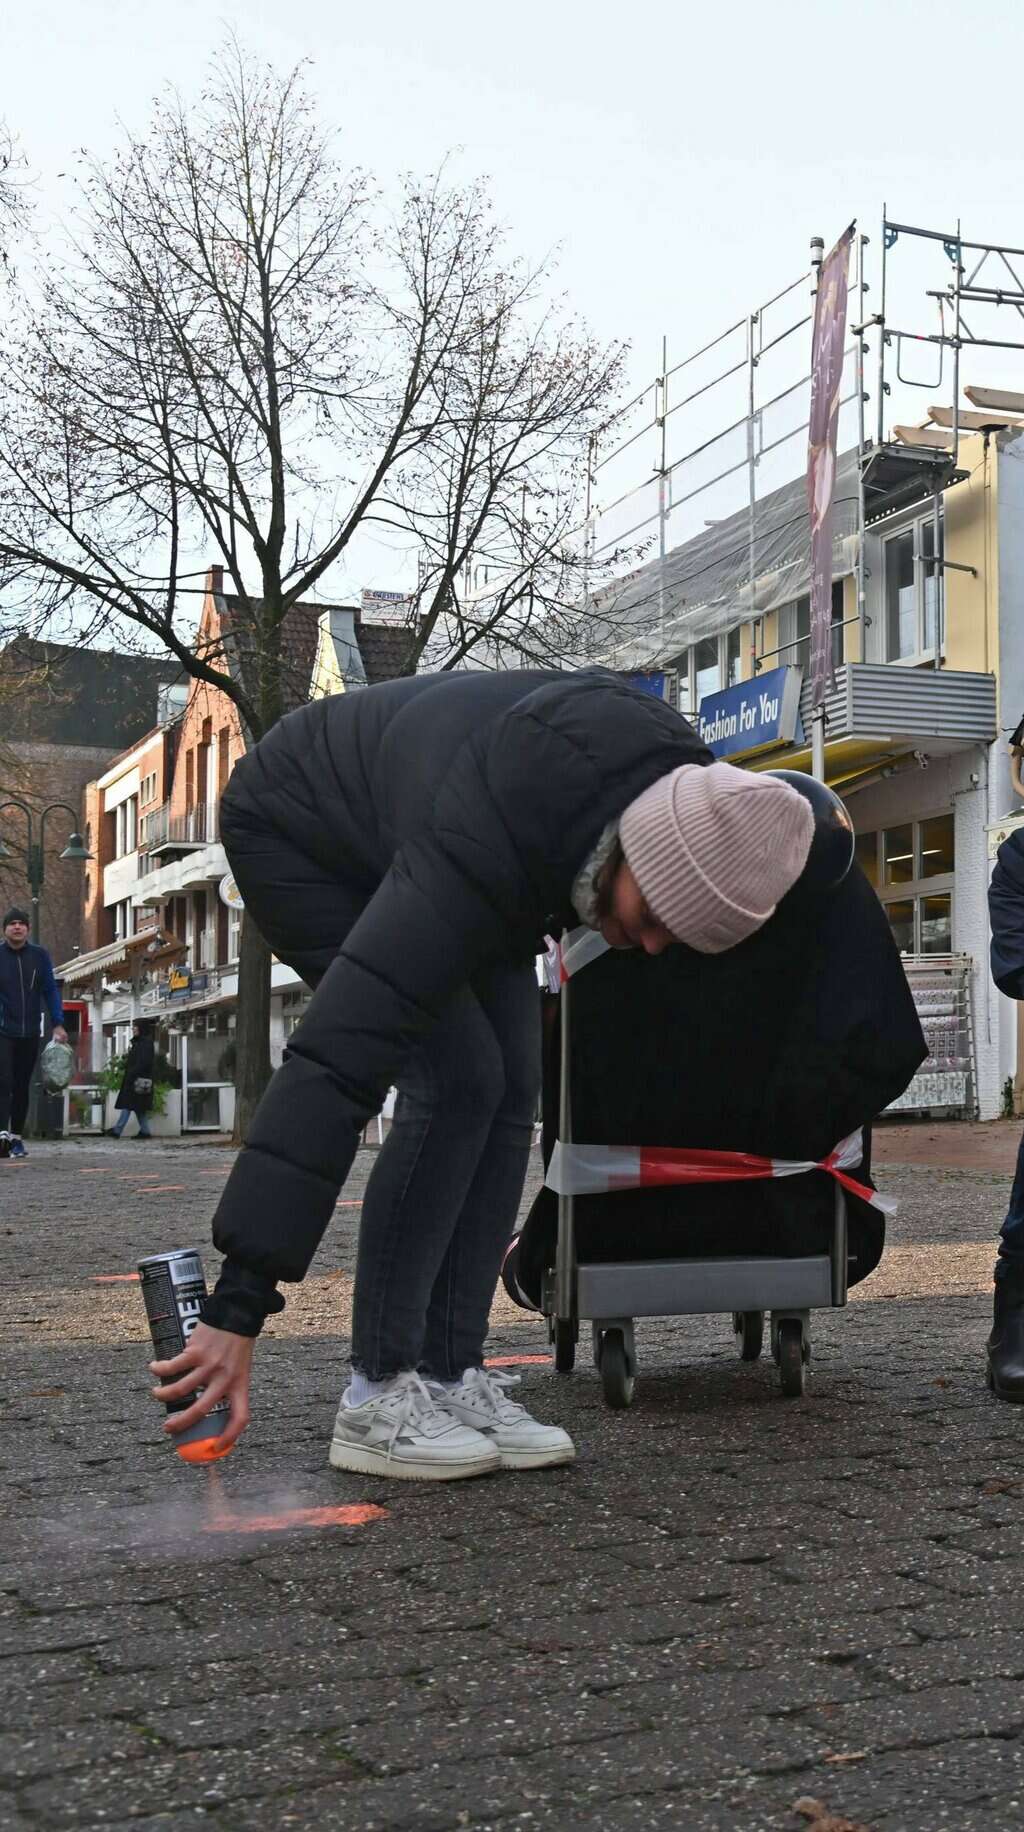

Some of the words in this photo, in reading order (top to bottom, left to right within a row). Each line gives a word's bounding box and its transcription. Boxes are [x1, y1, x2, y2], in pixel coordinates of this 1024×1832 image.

[699, 710, 737, 745] Fashion
[739, 701, 757, 733] For
[759, 692, 779, 725] You
